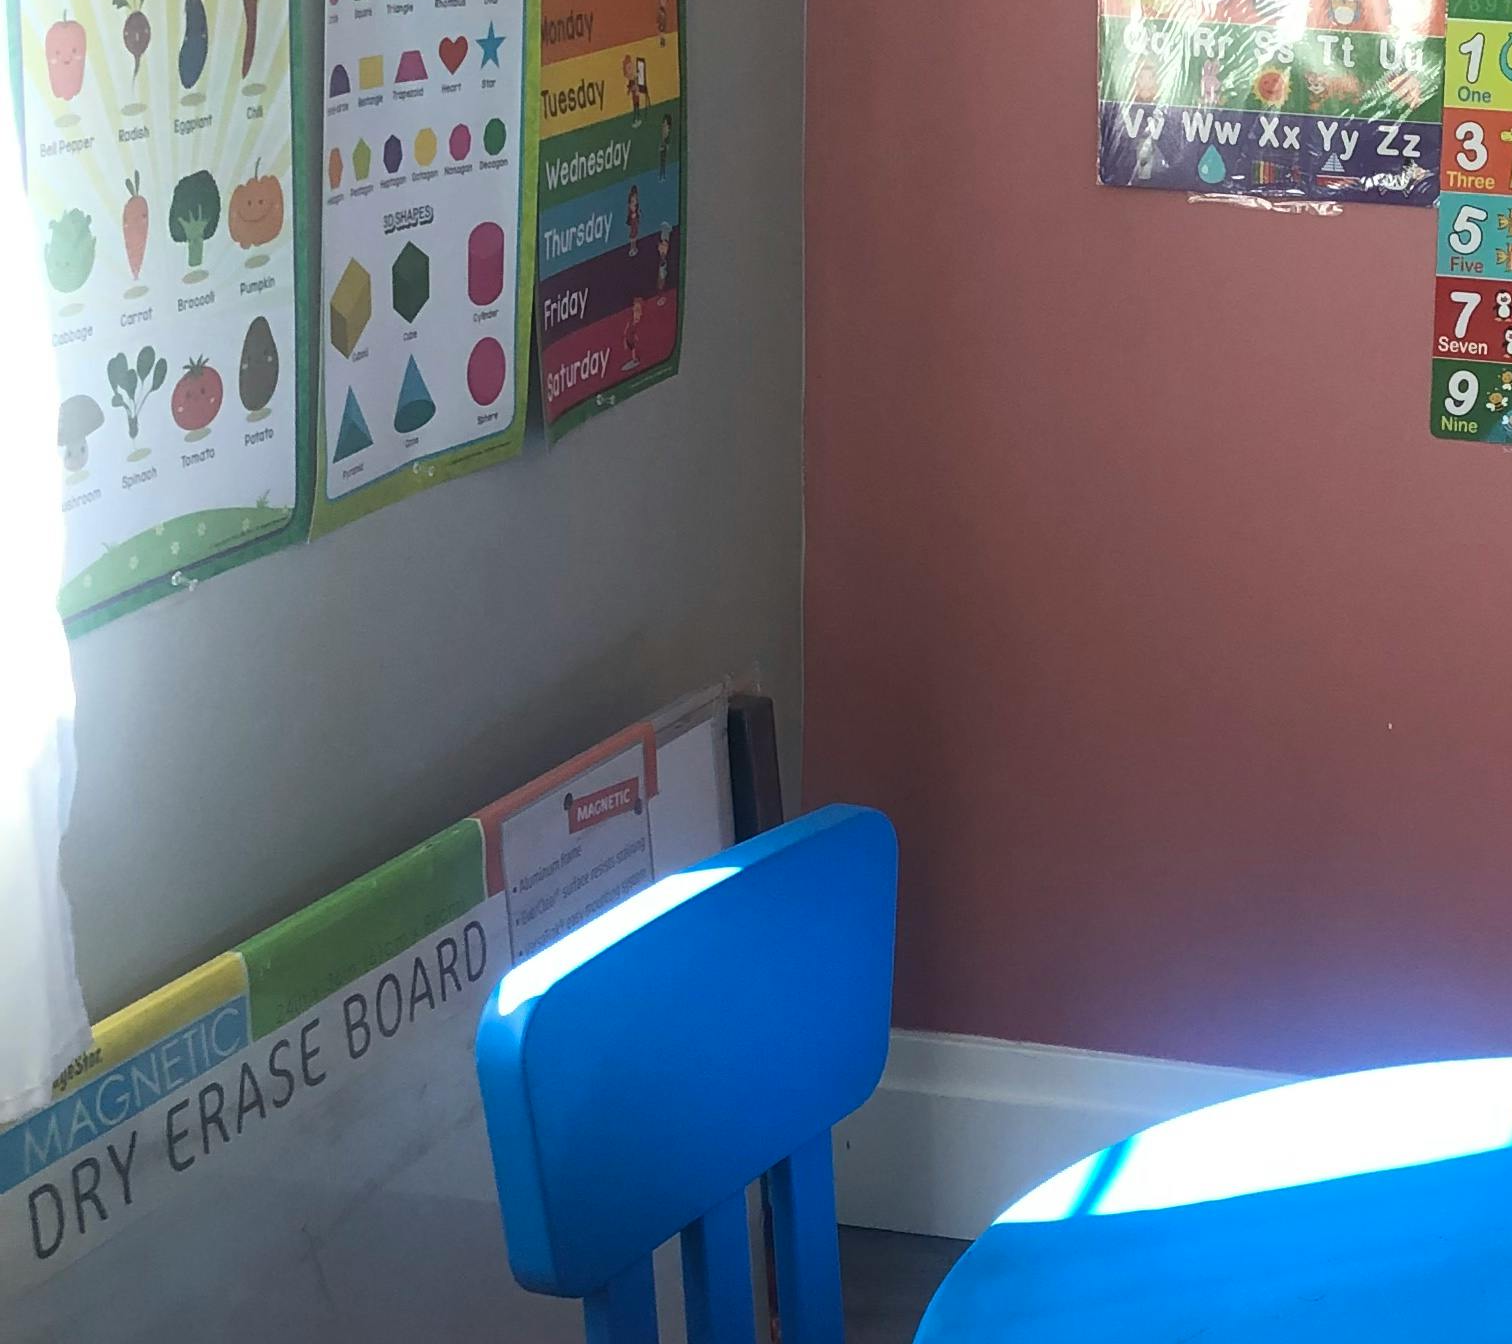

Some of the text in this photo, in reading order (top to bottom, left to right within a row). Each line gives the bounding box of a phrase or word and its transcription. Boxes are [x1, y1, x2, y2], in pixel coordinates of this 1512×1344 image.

[1458, 32, 1486, 84] 1
[541, 79, 605, 118] Tuesday
[1457, 86, 1492, 104] One
[1182, 111, 1421, 160] Ww Xx Yy Zz
[1455, 121, 1488, 171] 3
[545, 140, 631, 191] Wednesday
[1446, 171, 1496, 189] Three
[394, 204, 433, 230] SHAPES
[543, 213, 613, 259] Thursday
[1449, 205, 1488, 255] 5
[1450, 256, 1484, 273] Five
[177, 290, 216, 312] Broccoli
[240, 276, 276, 296] Pumpkin
[120, 308, 153, 327] Carrot
[543, 286, 589, 330] Friday
[1450, 291, 1482, 339] 7
[1438, 337, 1488, 355] Seven
[546, 348, 610, 402] Saturday
[1444, 370, 1479, 416] 9
[244, 427, 275, 446] Potato
[1441, 416, 1478, 434] Nine
[180, 447, 216, 468] Tomato
[576, 788, 631, 822] MAGNETIC
[22, 1006, 241, 1175] MAGNETIC
[28, 1130, 136, 1260] DRY
[163, 1017, 328, 1173] ERASE
[341, 919, 488, 1060] BOARD
